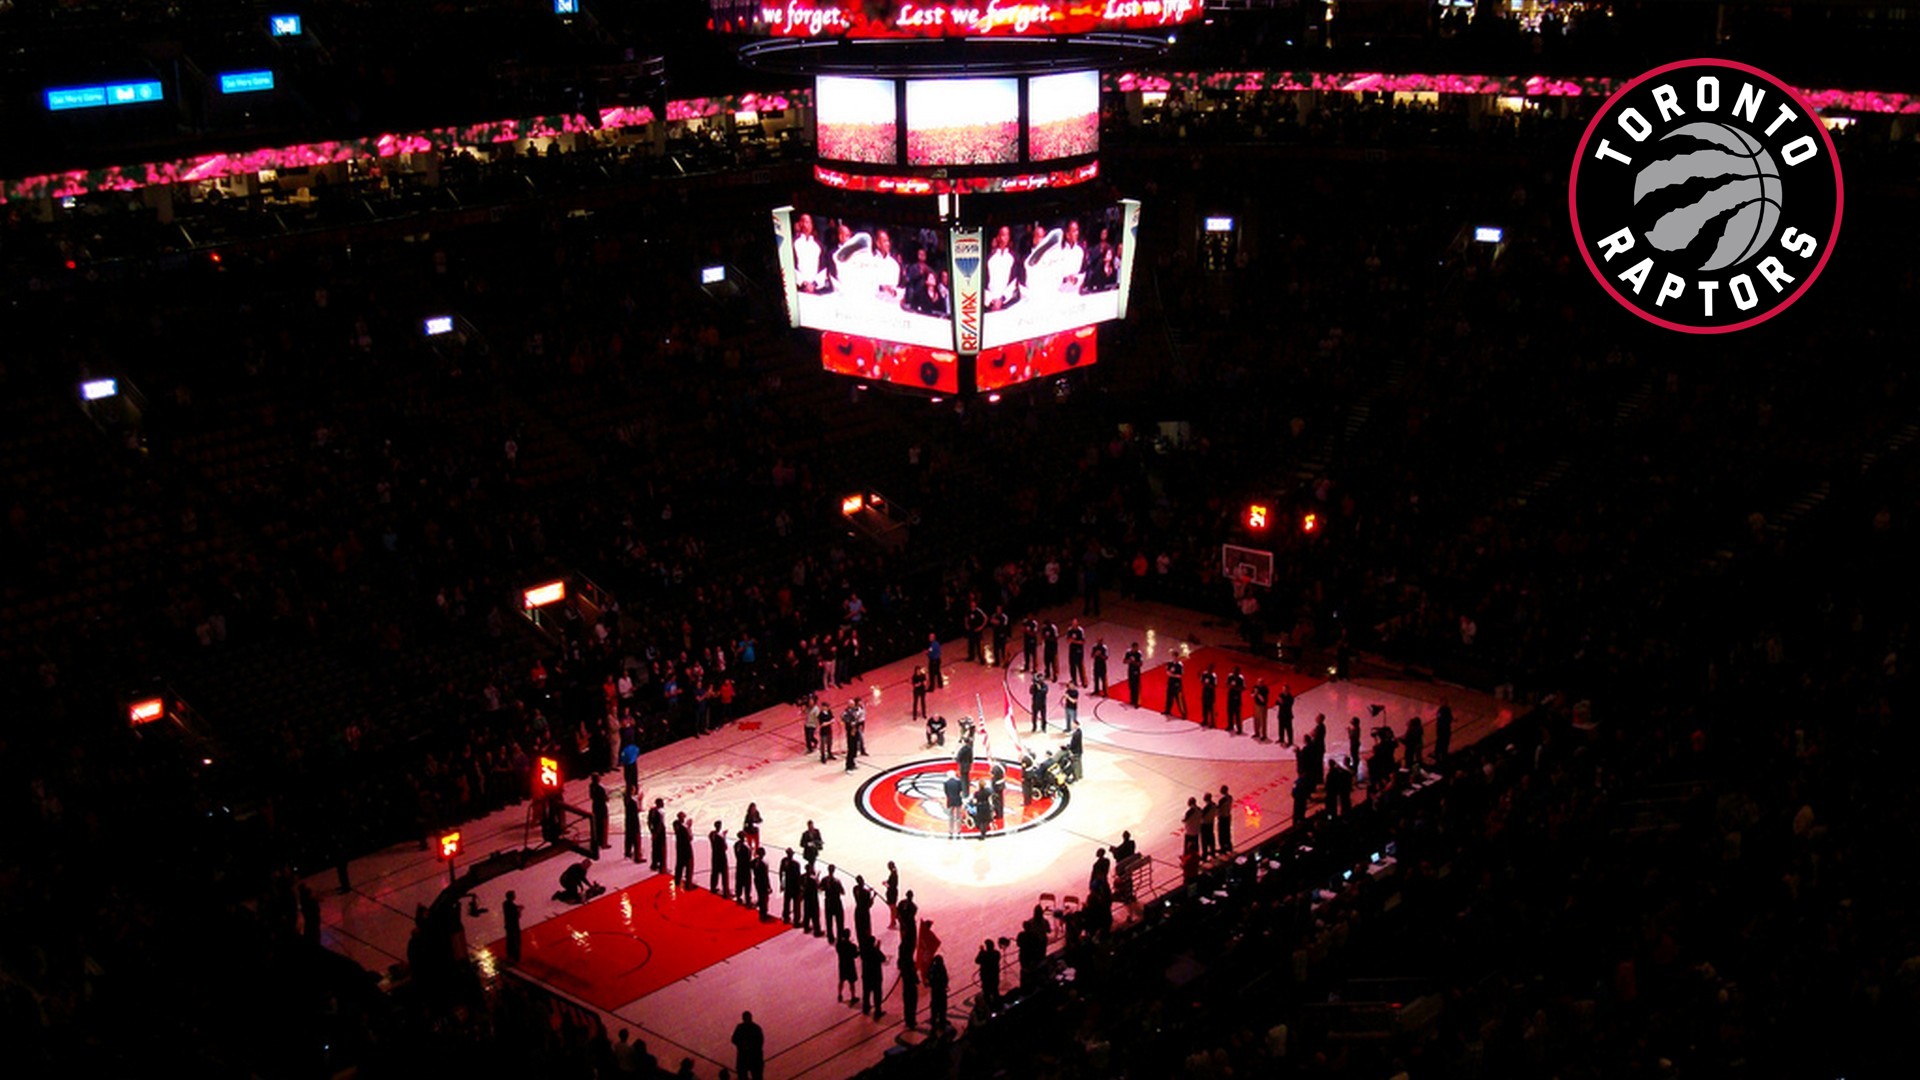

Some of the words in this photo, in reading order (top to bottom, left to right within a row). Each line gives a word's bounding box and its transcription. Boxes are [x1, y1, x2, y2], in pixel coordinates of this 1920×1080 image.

[762, 8, 782, 25] we
[896, 4, 944, 25] Lest
[951, 8, 979, 25] we
[980, 0, 1055, 34] forget.
[961, 291, 978, 352] RE/MAX
